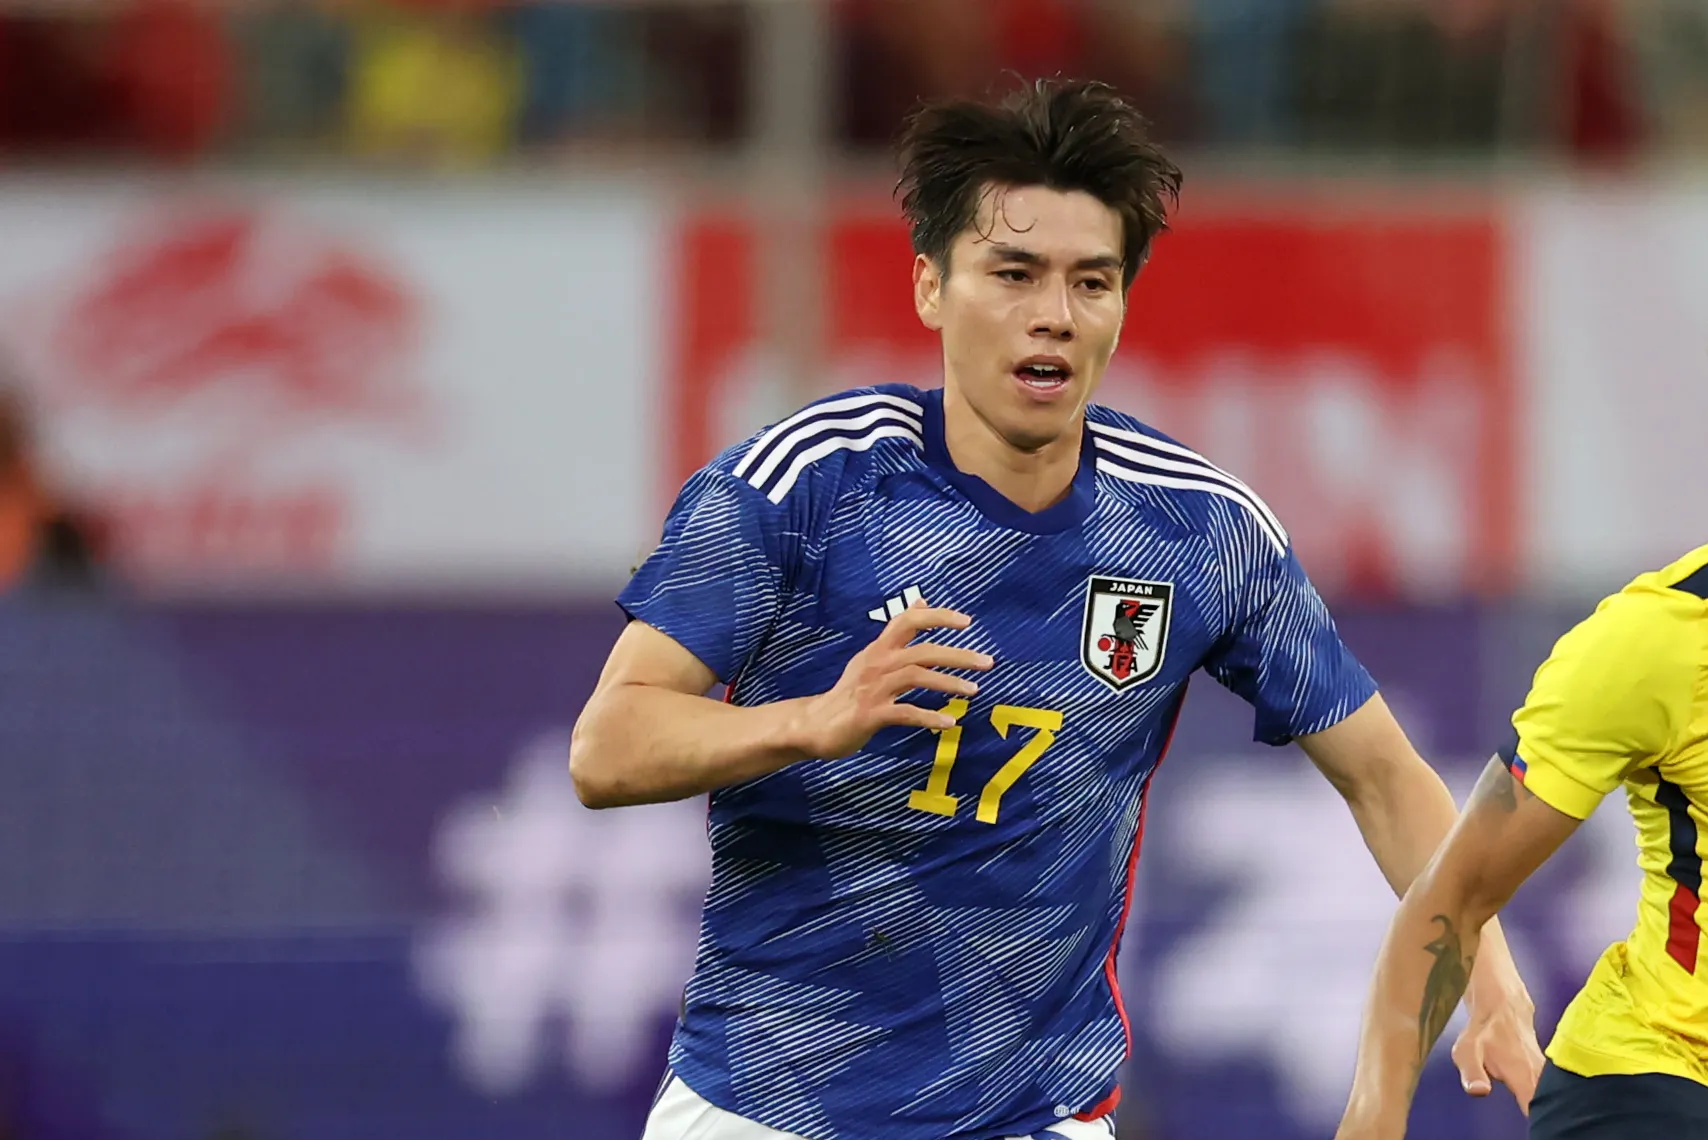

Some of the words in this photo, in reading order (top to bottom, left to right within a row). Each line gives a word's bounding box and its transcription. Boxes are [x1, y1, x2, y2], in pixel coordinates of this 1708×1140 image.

[1110, 582, 1153, 595] JAPAN
[1103, 654, 1138, 672] JFA
[907, 698, 1063, 824] 17
